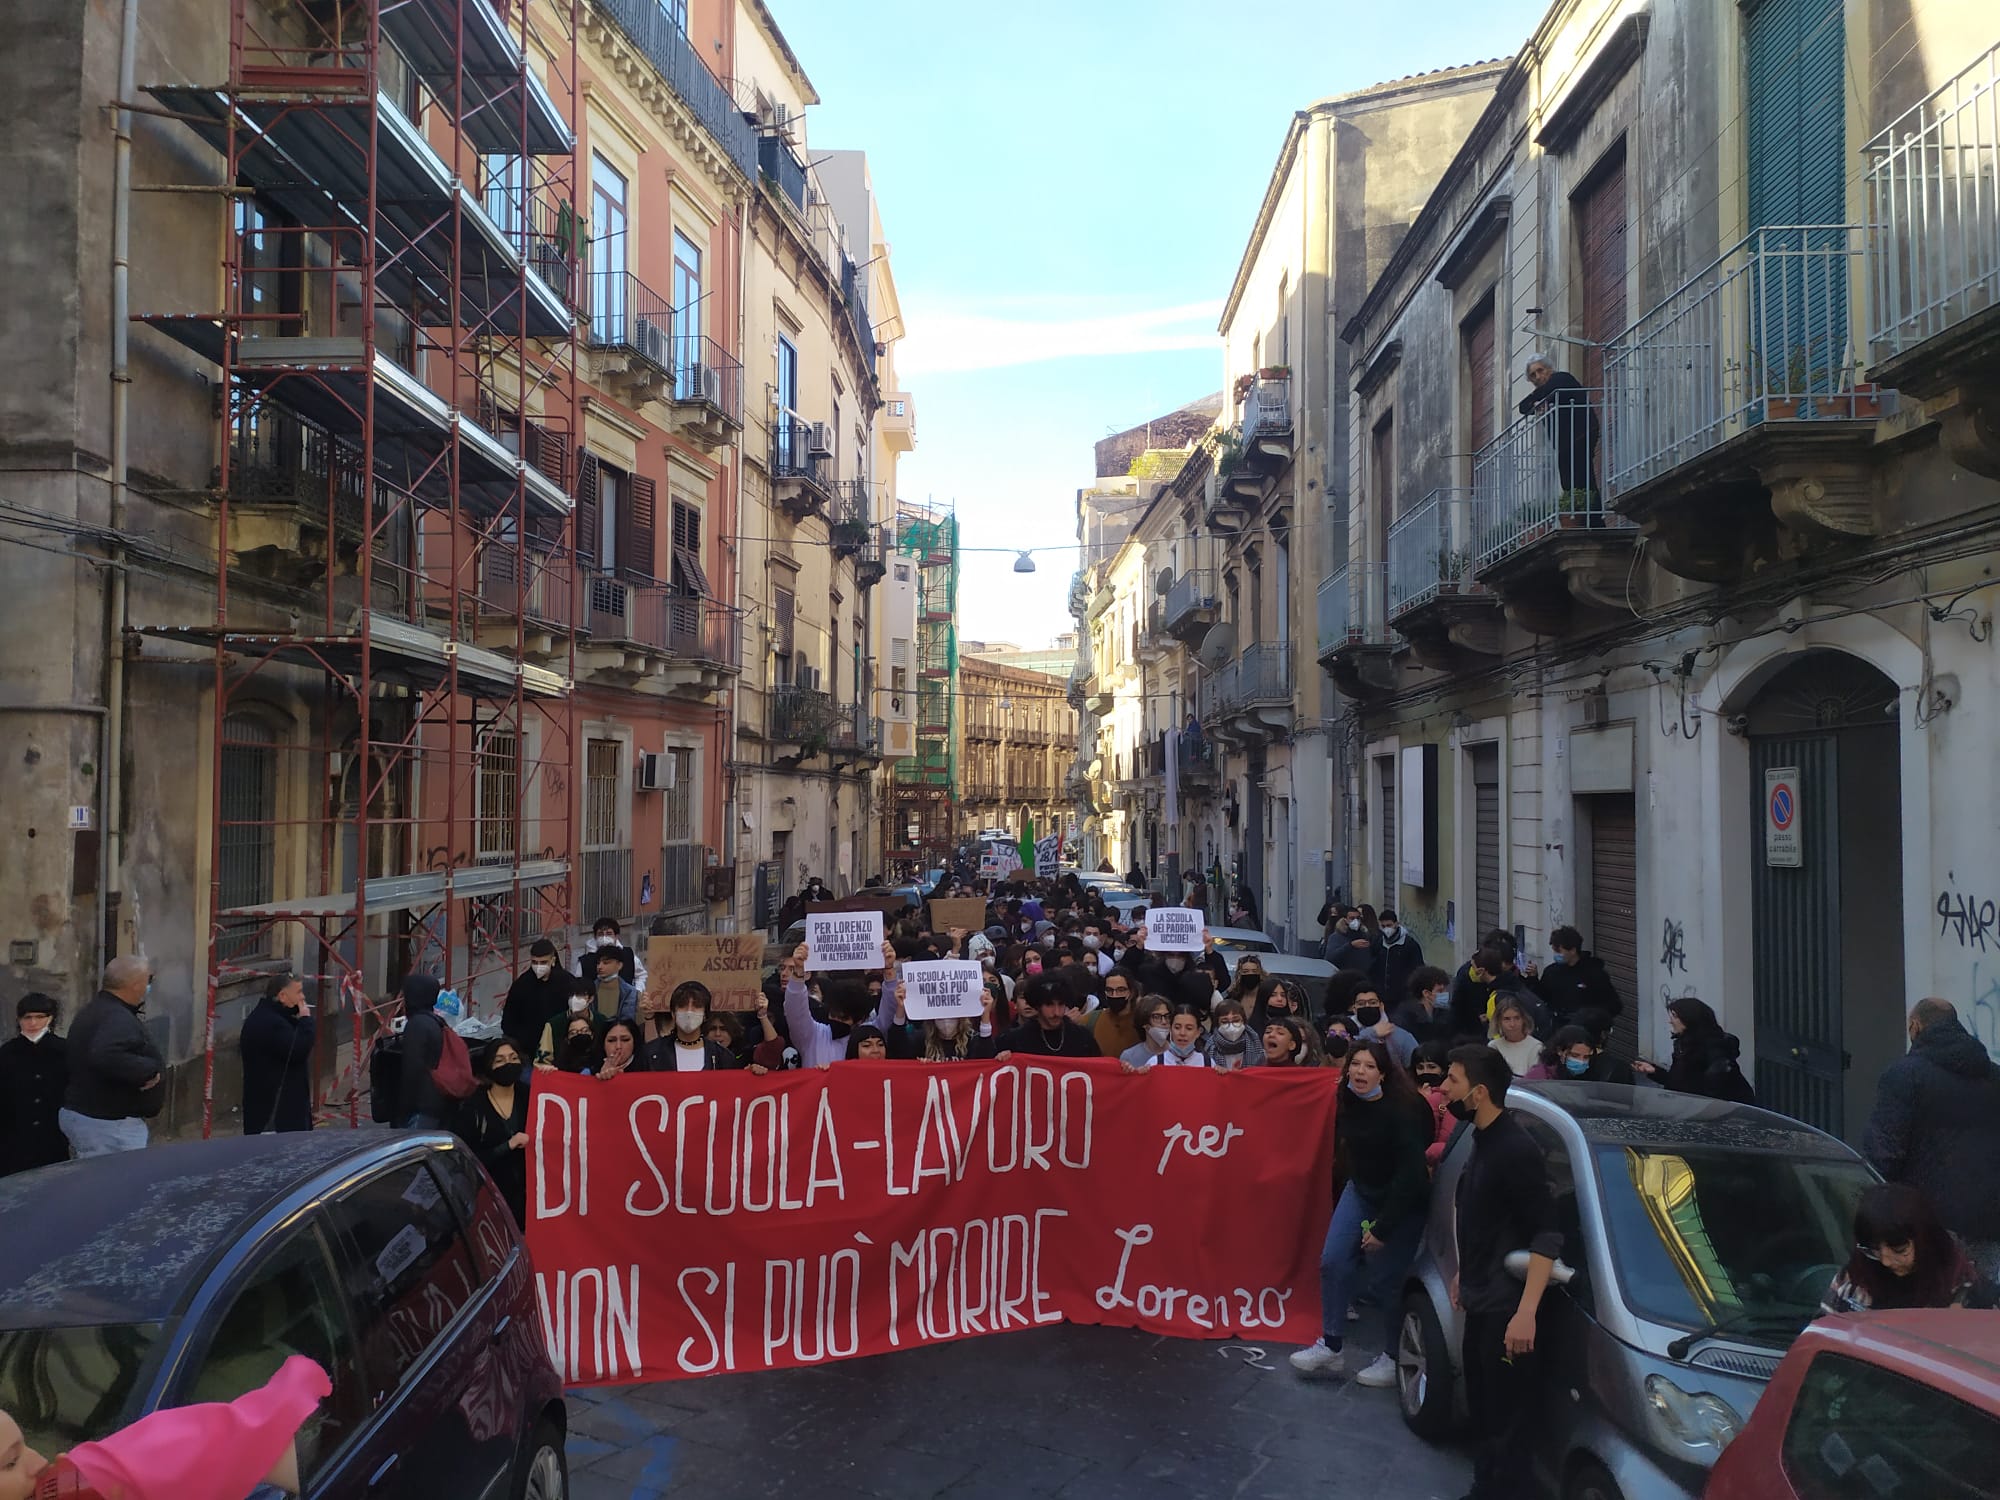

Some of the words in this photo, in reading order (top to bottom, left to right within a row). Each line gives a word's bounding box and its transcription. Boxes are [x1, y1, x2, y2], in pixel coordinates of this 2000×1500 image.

[1155, 913, 1165, 923] LA
[1166, 912, 1194, 923] SCUOLA
[814, 921, 832, 935] PER
[833, 919, 873, 934] LORENZO
[1152, 923, 1165, 934] DEI
[1166, 923, 1197, 934] PADRONI
[816, 934, 839, 944] MORTO
[840, 933, 845, 943] A
[855, 932, 871, 942] ANNI
[1160, 933, 1189, 944] UCCIDE!
[715, 937, 741, 955] VOI
[813, 943, 851, 953] LAVORANDO
[852, 941, 875, 951] GRATIS
[820, 952, 828, 961] IN
[828, 951, 868, 962] ALTERNANZA
[907, 971, 916, 983] DI
[916, 970, 979, 983] SCUOLA-LAVORO
[919, 982, 938, 995] NON
[939, 981, 949, 994] SI
[927, 994, 962, 1008] MORIRE
[534, 1092, 588, 1220] DI
[625, 1064, 1094, 1218] SCUOLA-LAVORO
[1157, 1122, 1244, 1176] per
[1095, 1223, 1293, 1330] Lorenzo
[534, 1264, 643, 1384] NON
[675, 1261, 736, 1375] SI
[763, 1231, 874, 1367] PUÒ
[889, 1208, 1069, 1347] MORIRE
